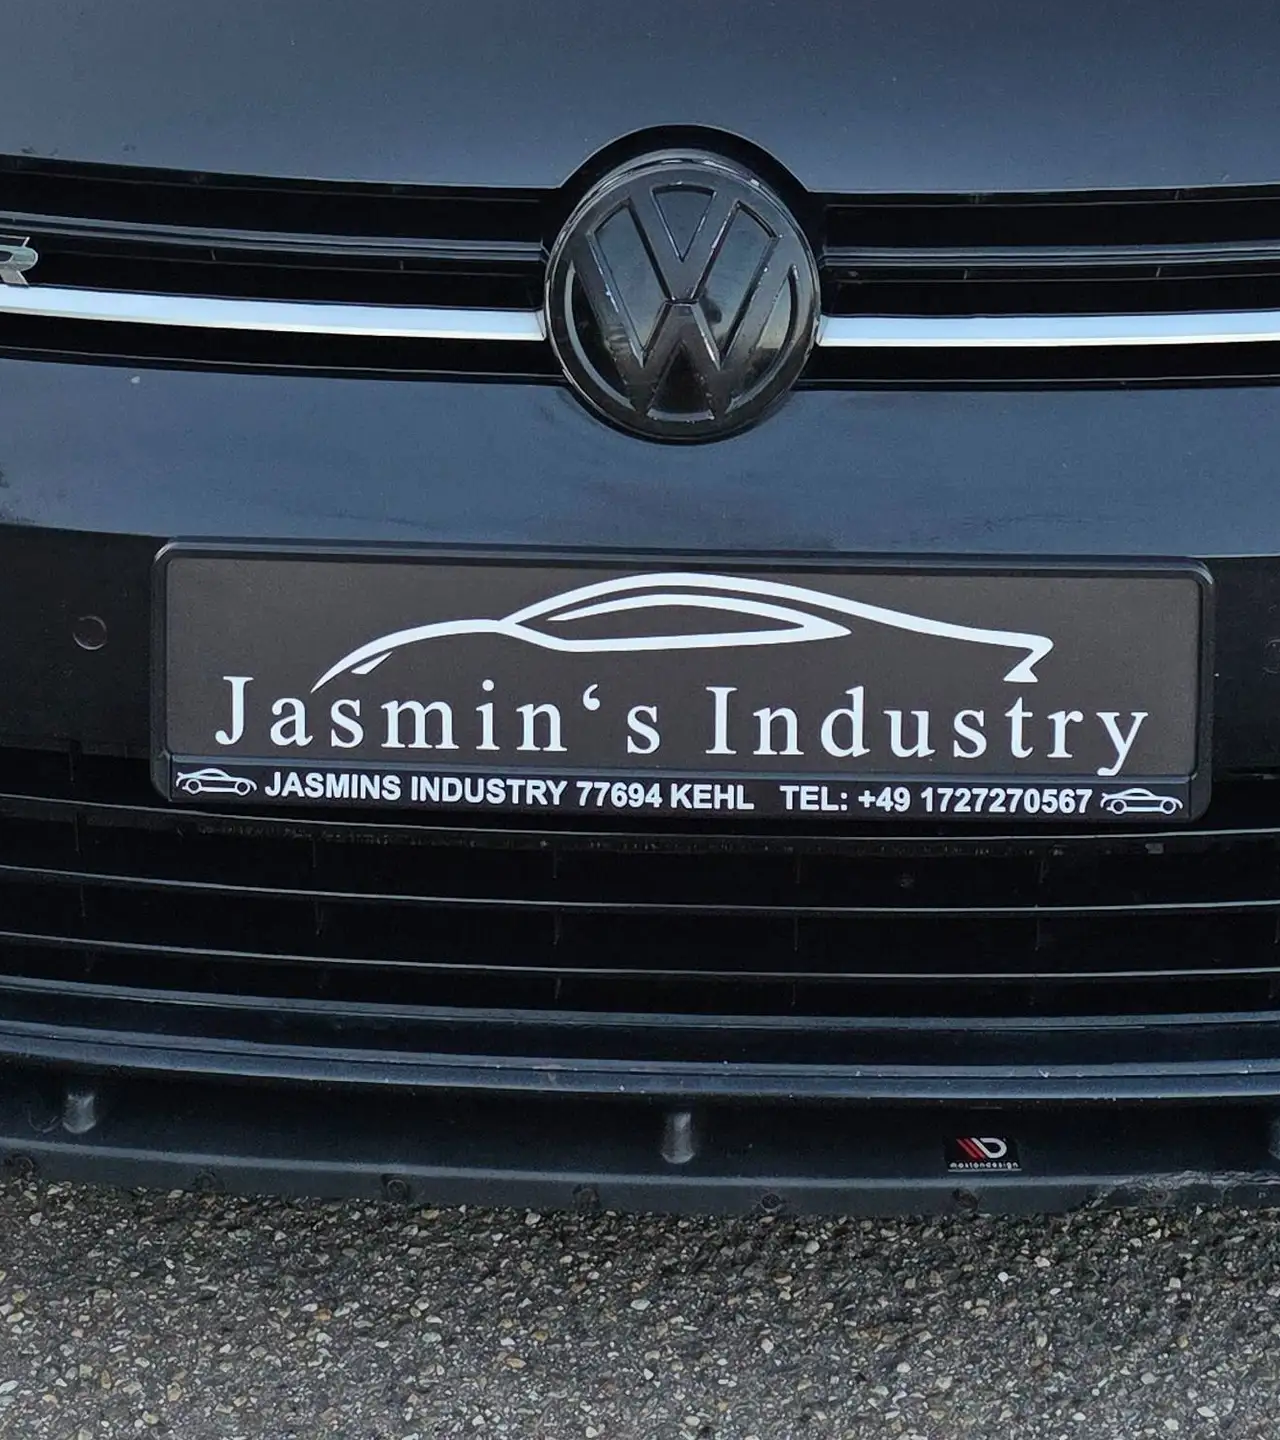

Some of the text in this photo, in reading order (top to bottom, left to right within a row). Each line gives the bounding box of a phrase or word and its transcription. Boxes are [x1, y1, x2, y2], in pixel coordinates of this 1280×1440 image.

[704, 685, 1150, 776] Industry
[264, 771, 1093, 814] JASMINS INDUSTRY 77694 KEHL TEL: +49 1727270567
